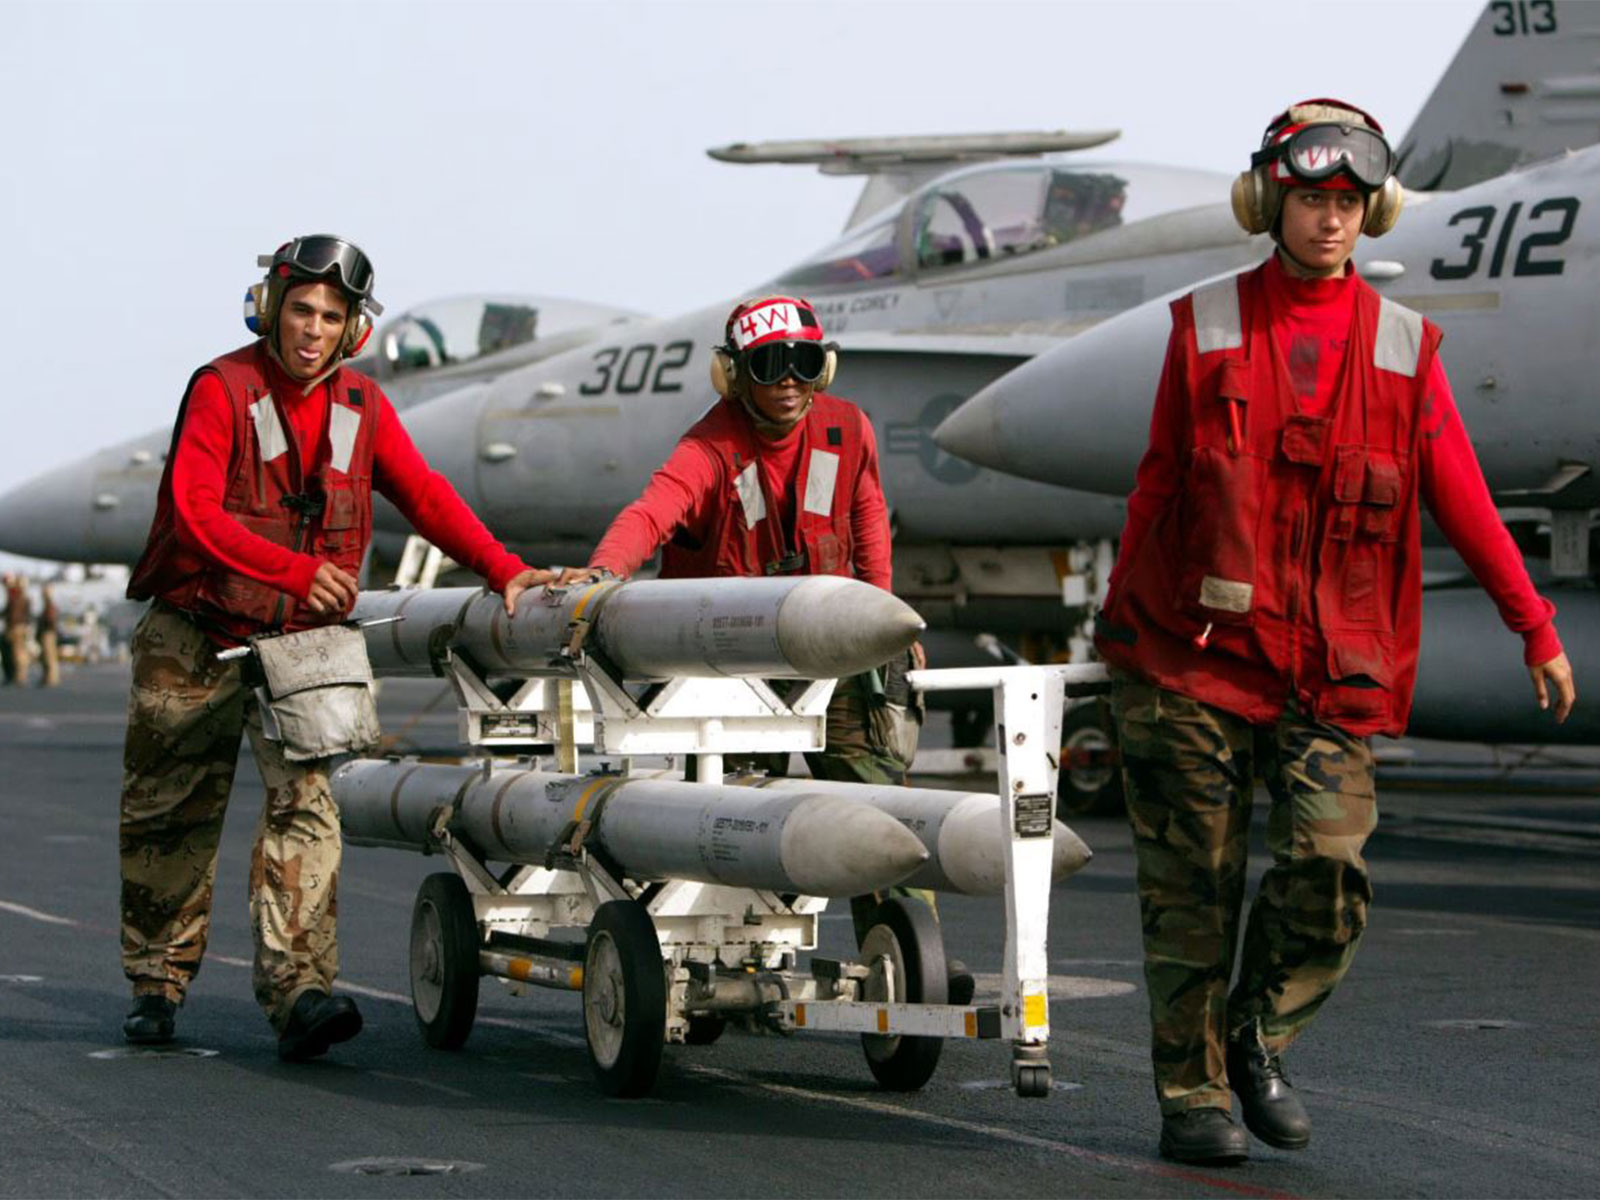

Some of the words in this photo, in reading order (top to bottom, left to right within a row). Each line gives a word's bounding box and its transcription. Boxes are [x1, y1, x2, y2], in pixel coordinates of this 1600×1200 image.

[1491, 0, 1556, 36] 313
[1430, 196, 1581, 280] 312
[739, 305, 789, 338] 4W
[579, 340, 694, 395] 302
